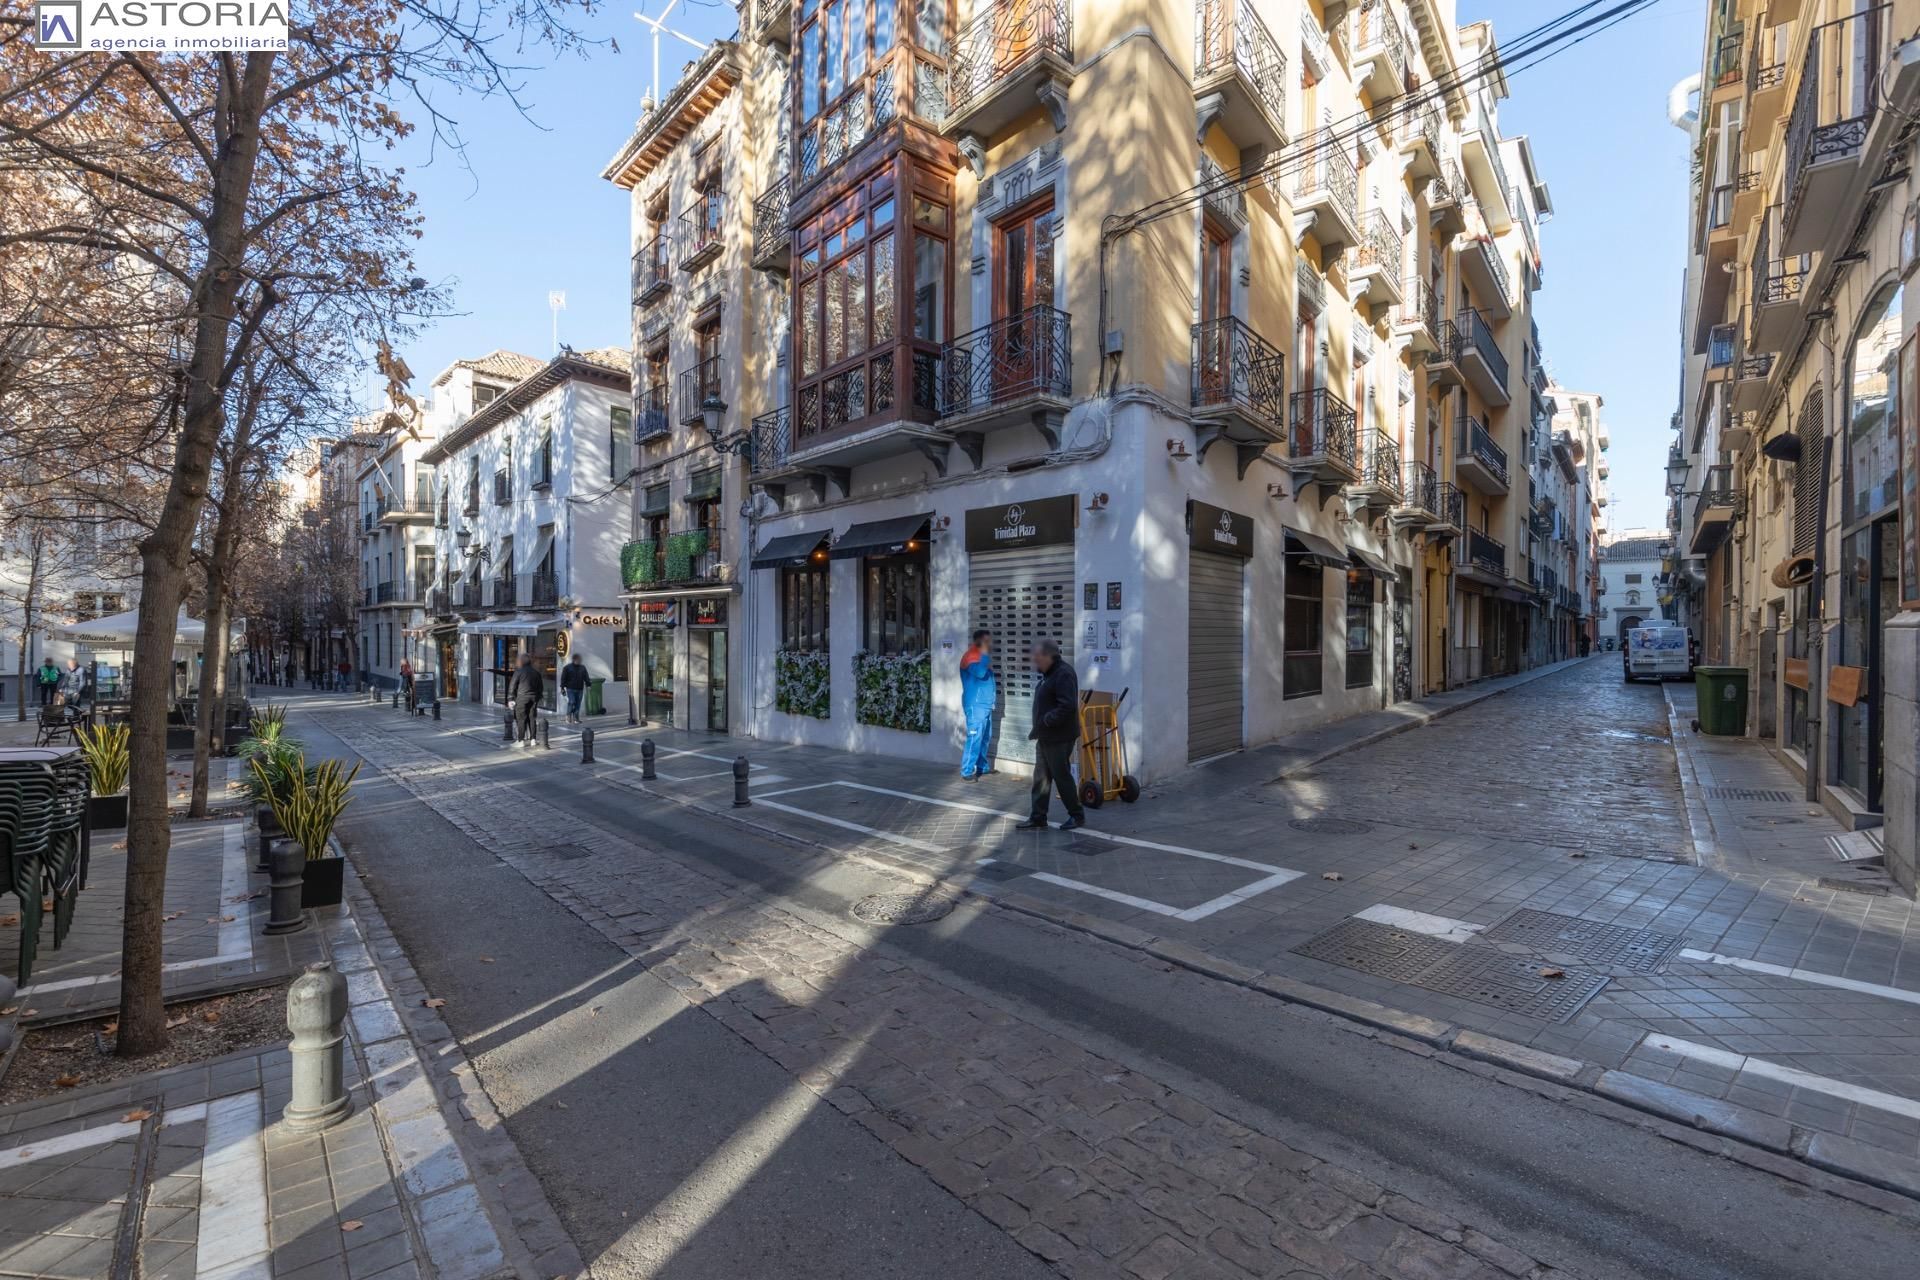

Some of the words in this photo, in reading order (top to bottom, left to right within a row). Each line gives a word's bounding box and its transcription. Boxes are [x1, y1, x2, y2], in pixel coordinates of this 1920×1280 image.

[994, 525, 1018, 540] Trinidad
[1018, 524, 1036, 538] Plaza
[582, 615, 610, 625] Café
